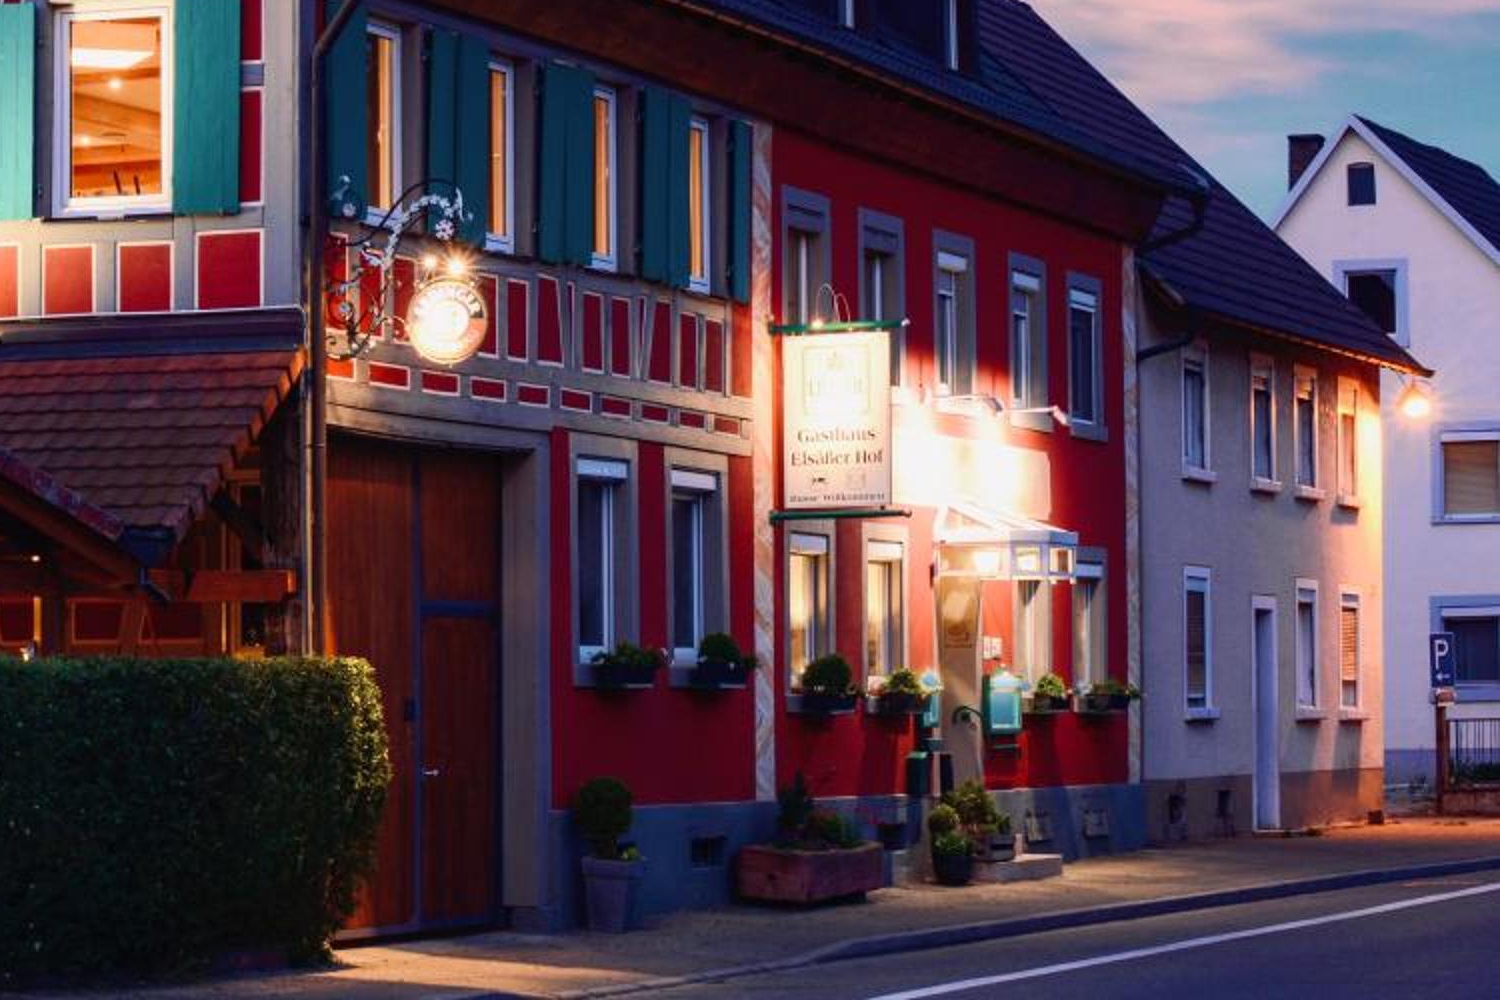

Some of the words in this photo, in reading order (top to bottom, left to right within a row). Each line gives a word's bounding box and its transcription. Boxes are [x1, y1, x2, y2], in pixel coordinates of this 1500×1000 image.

[797, 427, 876, 442] Gasthaus
[855, 448, 884, 463] Hof
[1434, 639, 1449, 671] P
